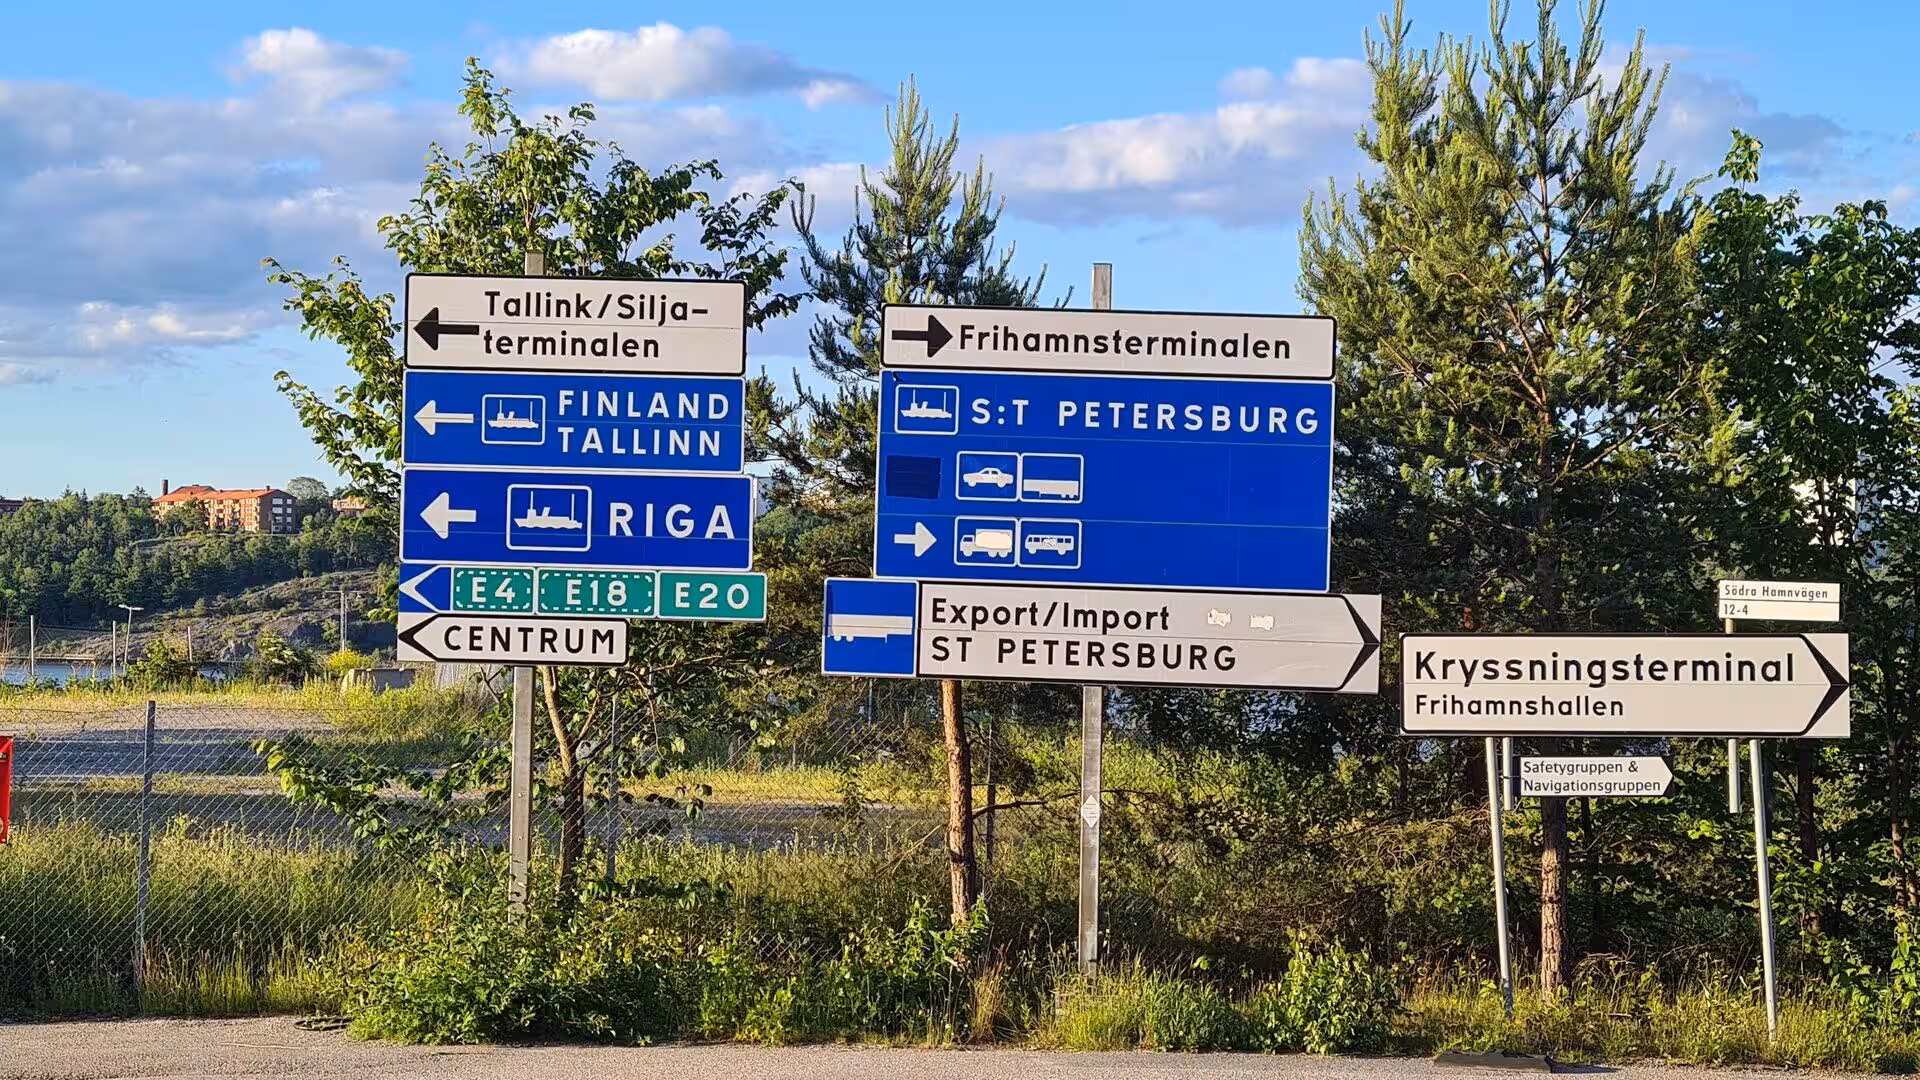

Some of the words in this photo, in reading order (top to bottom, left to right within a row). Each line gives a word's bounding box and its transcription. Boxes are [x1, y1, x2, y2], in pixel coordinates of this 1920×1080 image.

[484, 290, 709, 327] Tallink/Silja-
[483, 330, 659, 358] terminalen
[960, 324, 1291, 360] Frihamnsterminalen
[558, 389, 729, 420] FINLAND
[971, 398, 1030, 426] S:T
[1059, 401, 1319, 435] PETERSBURG
[557, 427, 720, 457] TALLINN
[609, 502, 735, 539] RIGA
[471, 576, 516, 604] E4
[566, 579, 627, 607] E18
[675, 582, 749, 609] E20
[1724, 584, 1757, 596] Södra
[1762, 586, 1828, 600] Hamnvägen
[931, 598, 1170, 635] Export/Import
[1724, 604, 1748, 615] 12-4
[444, 625, 615, 655] CENTRUM
[931, 636, 970, 663] ST
[999, 638, 1236, 672] PETERSBURG
[1415, 651, 1794, 688] Kryssningsterminal
[1415, 694, 1624, 717] Frihamnshallen
[1523, 760, 1623, 775] Safetygruppen
[1628, 760, 1639, 773] &
[1523, 779, 1661, 793] Navigationsgruppen
